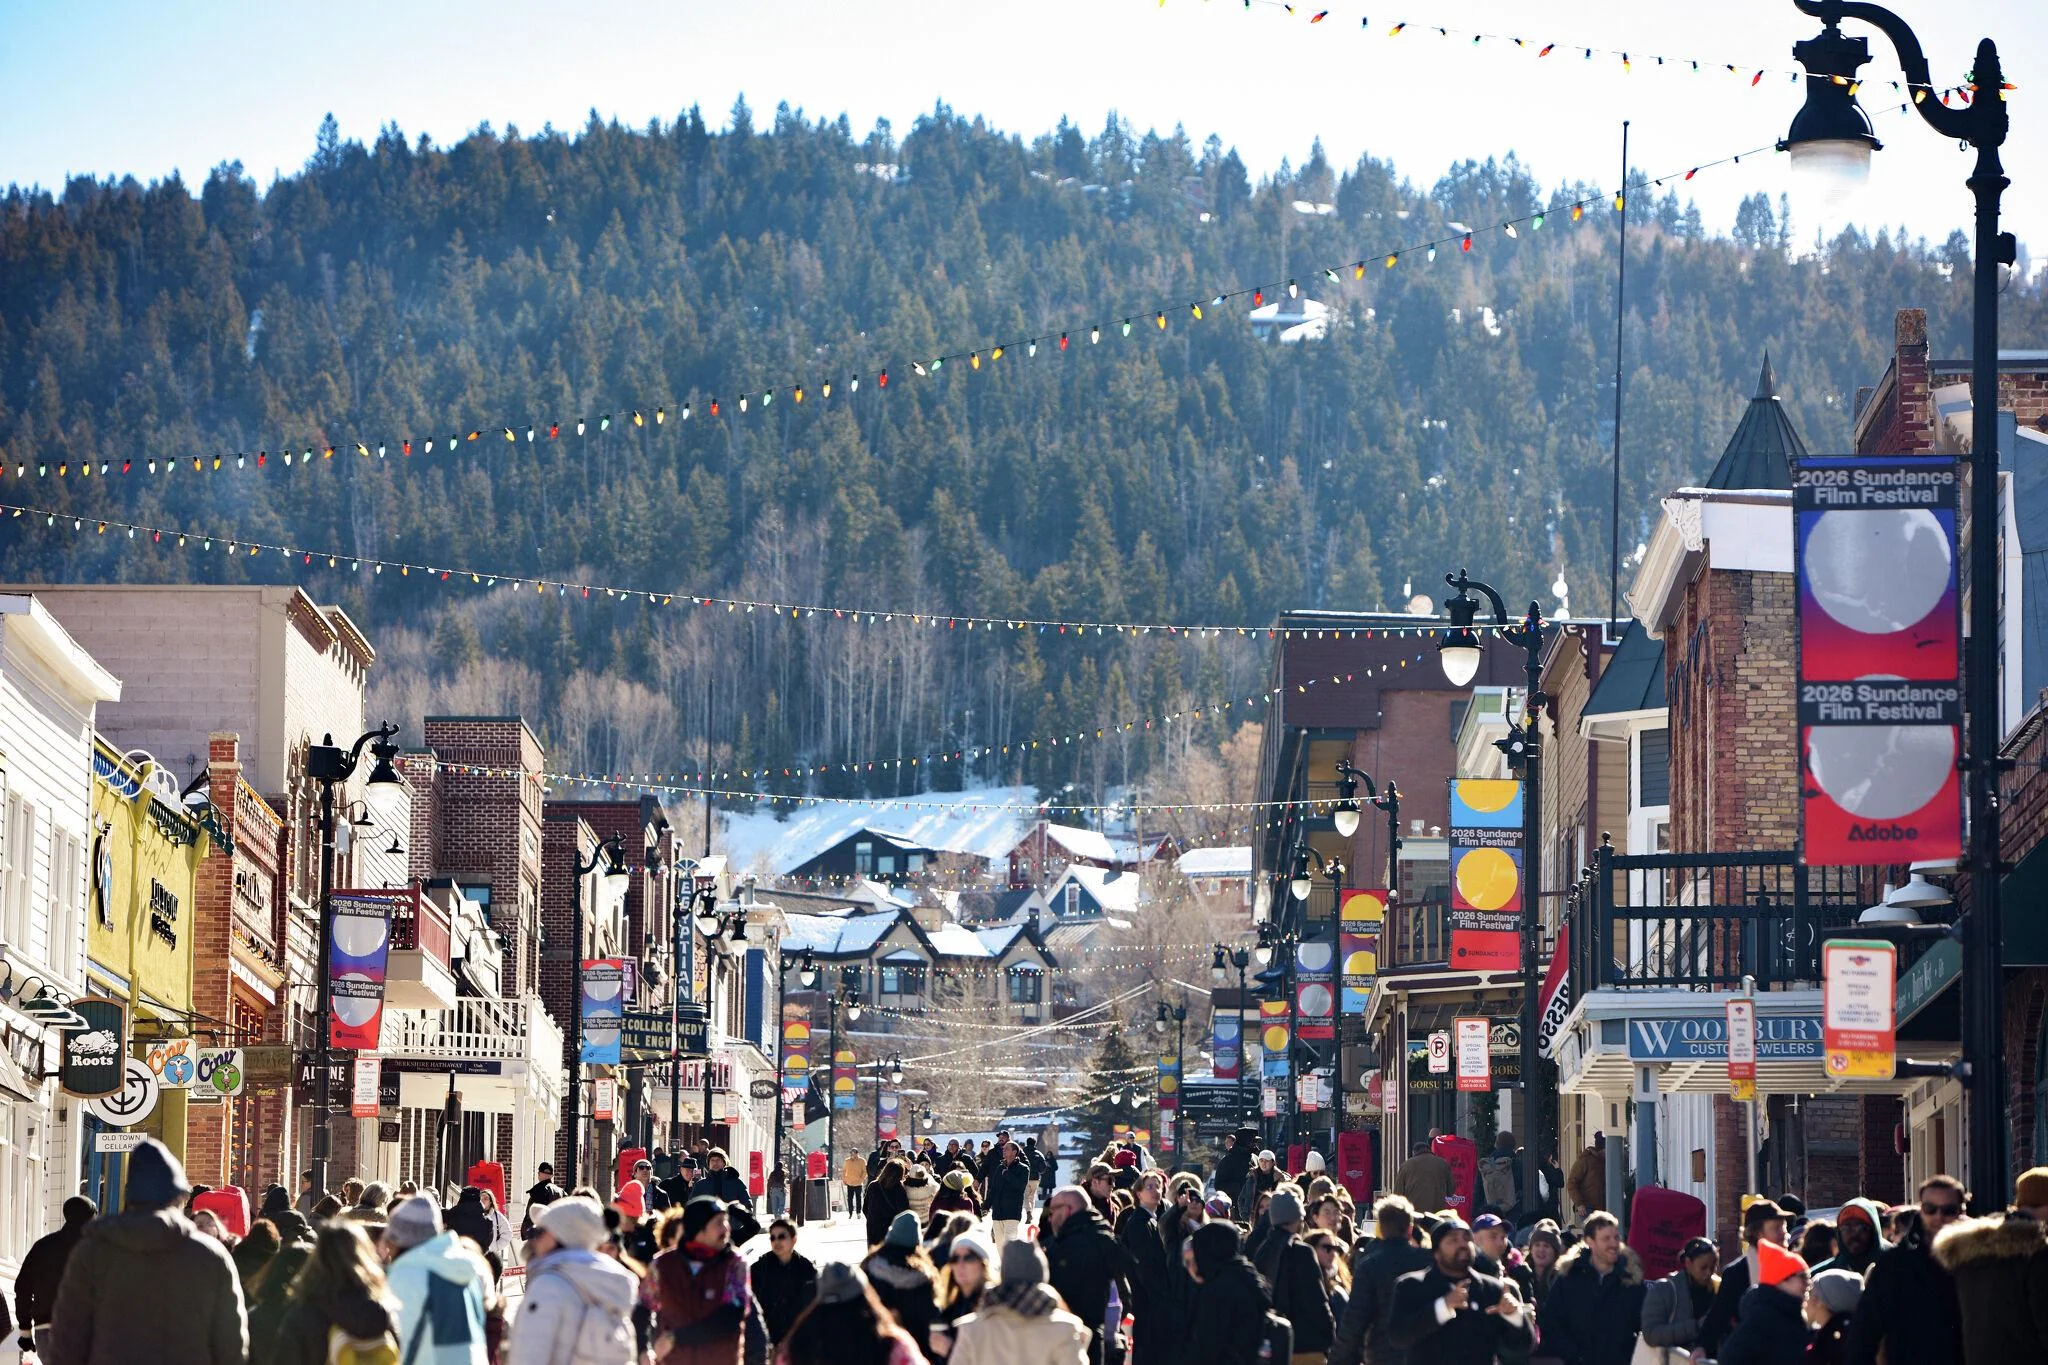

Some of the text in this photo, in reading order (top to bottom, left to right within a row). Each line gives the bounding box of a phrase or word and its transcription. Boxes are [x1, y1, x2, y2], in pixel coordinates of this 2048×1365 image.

[1799, 469, 1954, 487] 2026 Sundance
[1815, 486, 1939, 504] Film Festival
[1803, 685, 1958, 702] 2026 Sundance
[1819, 703, 1942, 720] Film Festival
[1451, 829, 1523, 839] 2026 Sundance
[1847, 822, 1919, 842] Adobe
[1459, 838, 1515, 847] Film Festival
[332, 899, 391, 910] 2026 Sundance
[338, 906, 384, 917] Film Festival
[1452, 911, 1520, 921] 2026 Sundance
[1460, 920, 1514, 930] Film Festival
[330, 980, 383, 991] 2026 Sundance
[348, 989, 377, 997] Festival
[628, 1019, 663, 1033] COLLAR
[665, 1022, 704, 1036] CMEDY
[646, 1035, 689, 1050] ENGVLL
[1632, 1020, 1824, 1055] WOOBURY
[1690, 1042, 1815, 1055] CUSTO EWELERS
[71, 1055, 114, 1066] Roots
[430, 1061, 463, 1069] HATHAWAY
[302, 1066, 345, 1081] ALNE
[1490, 1065, 1520, 1076] GORS
[1409, 1080, 1454, 1089] GORSUH
